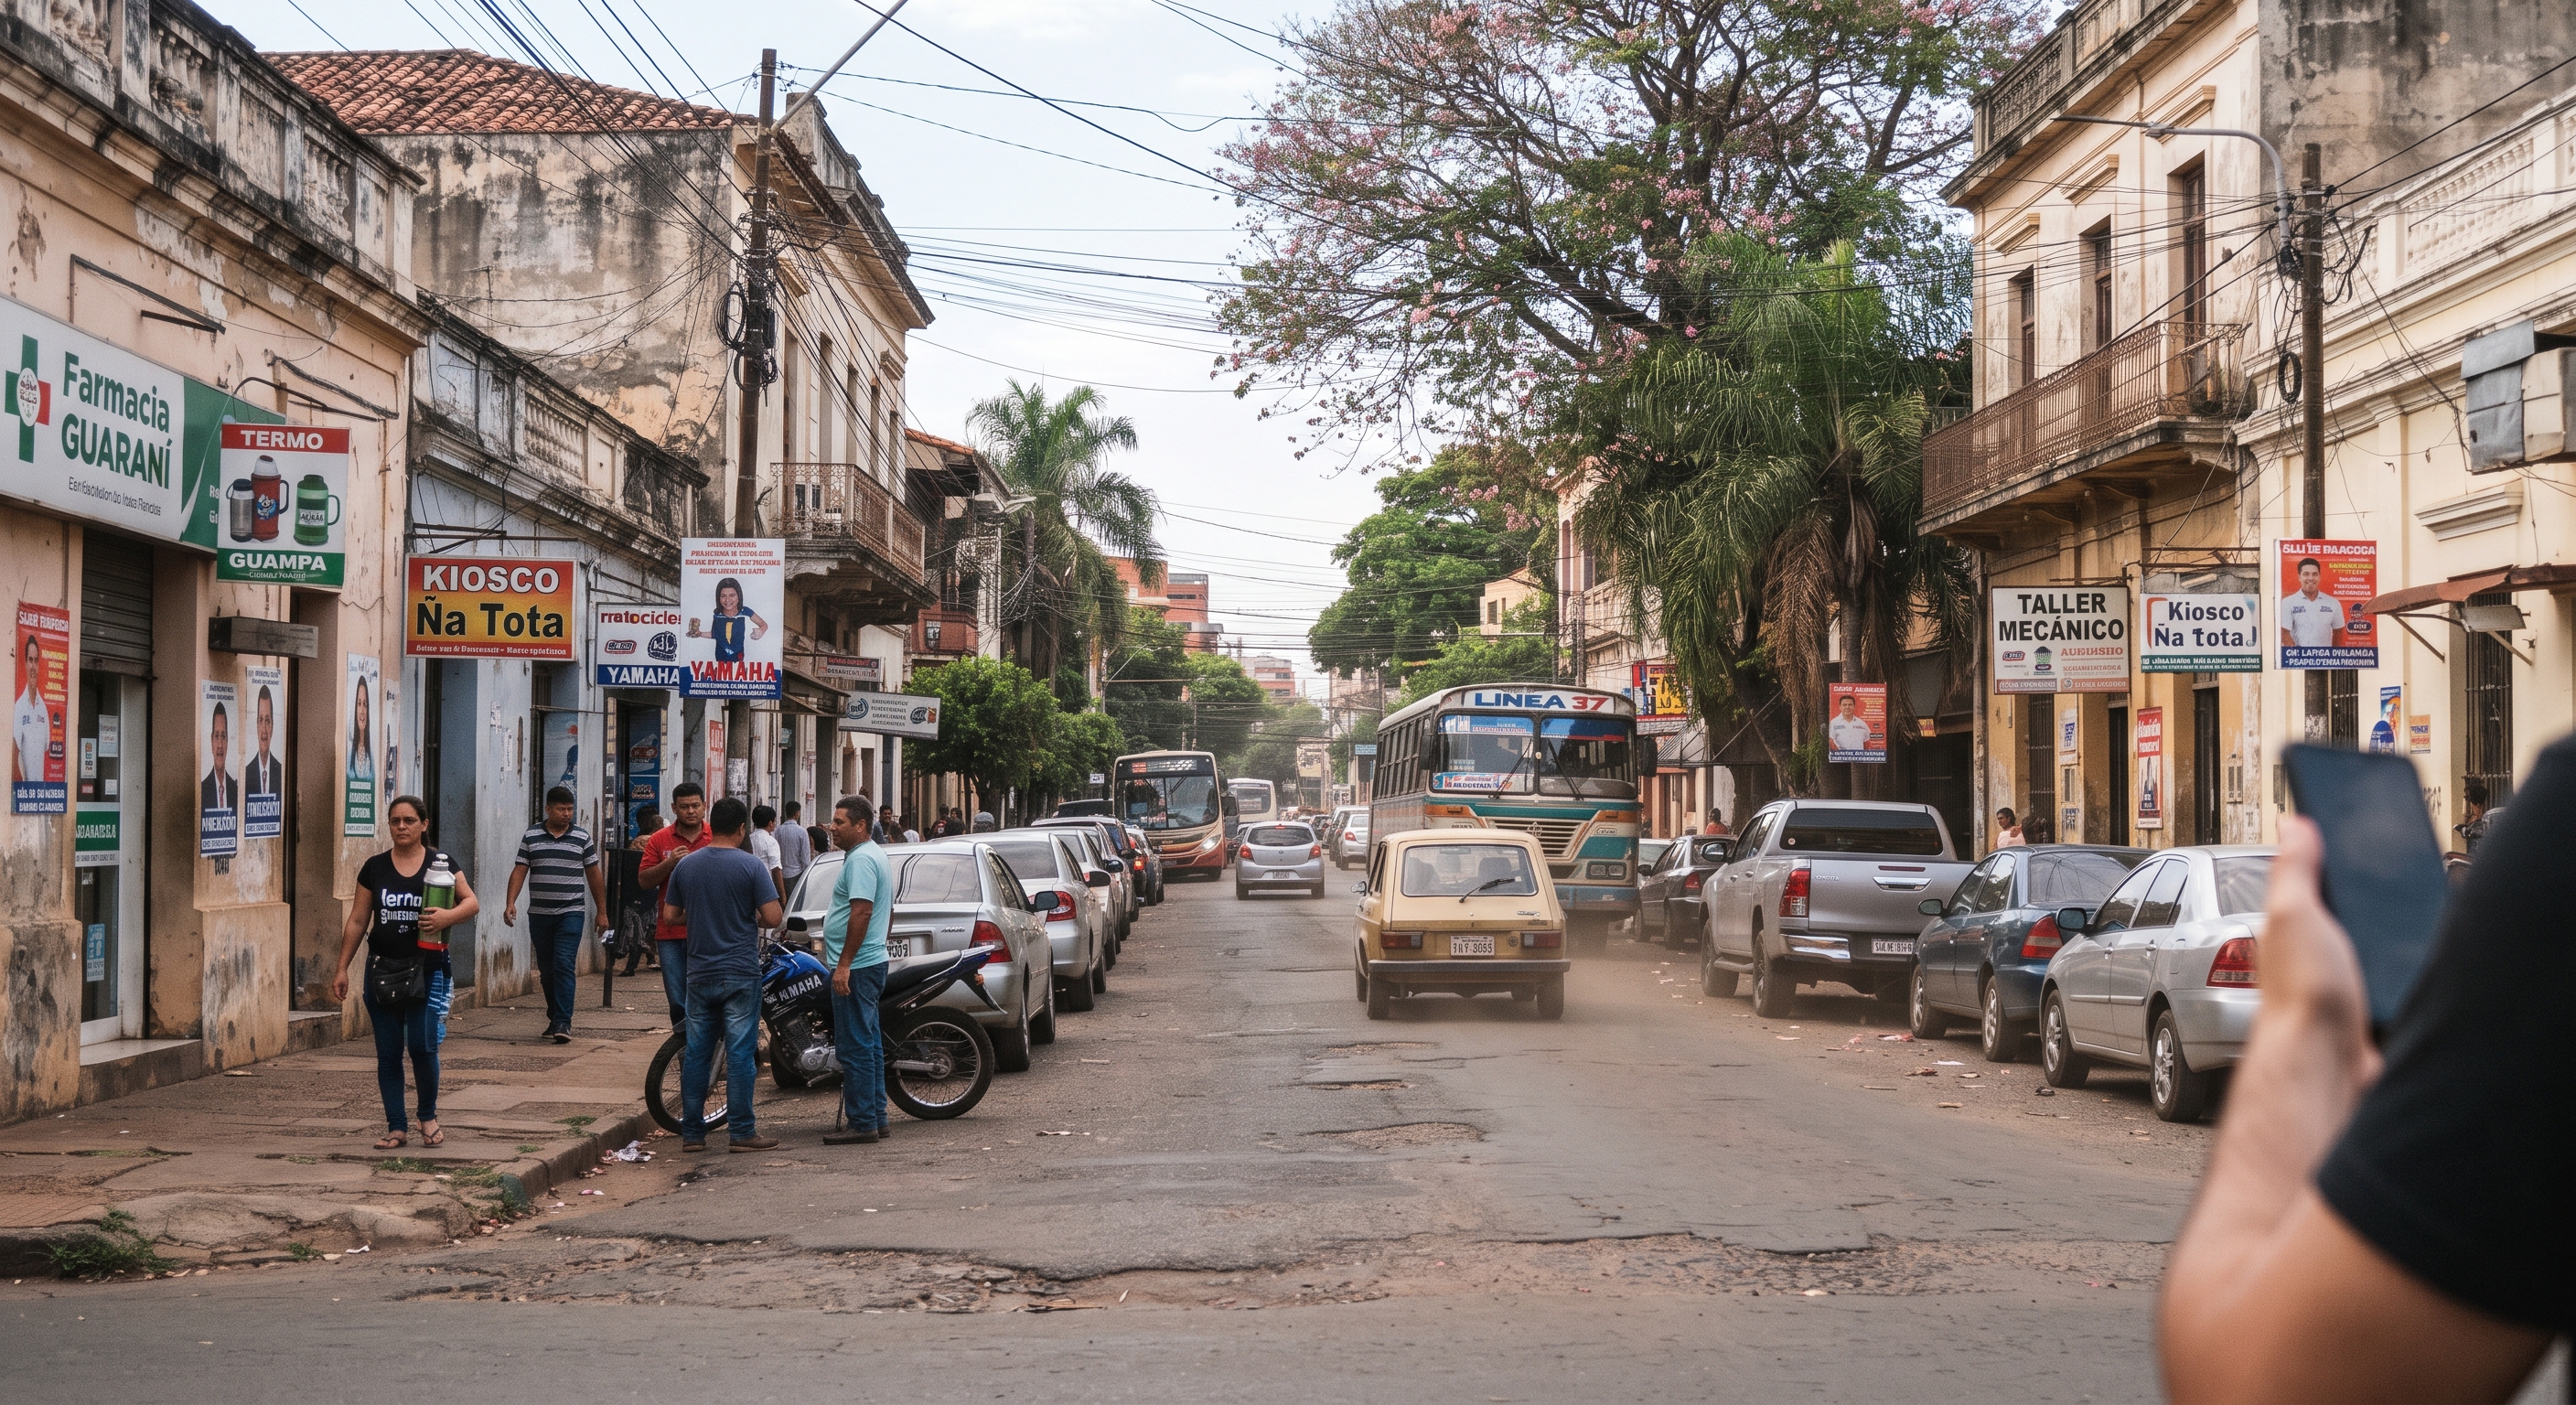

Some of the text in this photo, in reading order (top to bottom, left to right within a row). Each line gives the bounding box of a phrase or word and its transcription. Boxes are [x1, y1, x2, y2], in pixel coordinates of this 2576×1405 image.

[63, 351, 170, 434] Farmacia
[240, 430, 324, 449] TERMO
[61, 413, 173, 489] GUARANÍ
[229, 552, 327, 571] GUAMPA
[423, 563, 560, 594] KIOSCO
[2017, 593, 2107, 614] TALLER
[2168, 601, 2244, 621] Kiosco
[416, 595, 564, 638] Ña Tota
[1999, 616, 2124, 641] MECÁNICO
[2154, 623, 2184, 647] Ña
[606, 667, 680, 684] YAMAHA
[691, 660, 777, 682] YAMAHA
[1475, 692, 1609, 711] LINEA 37
